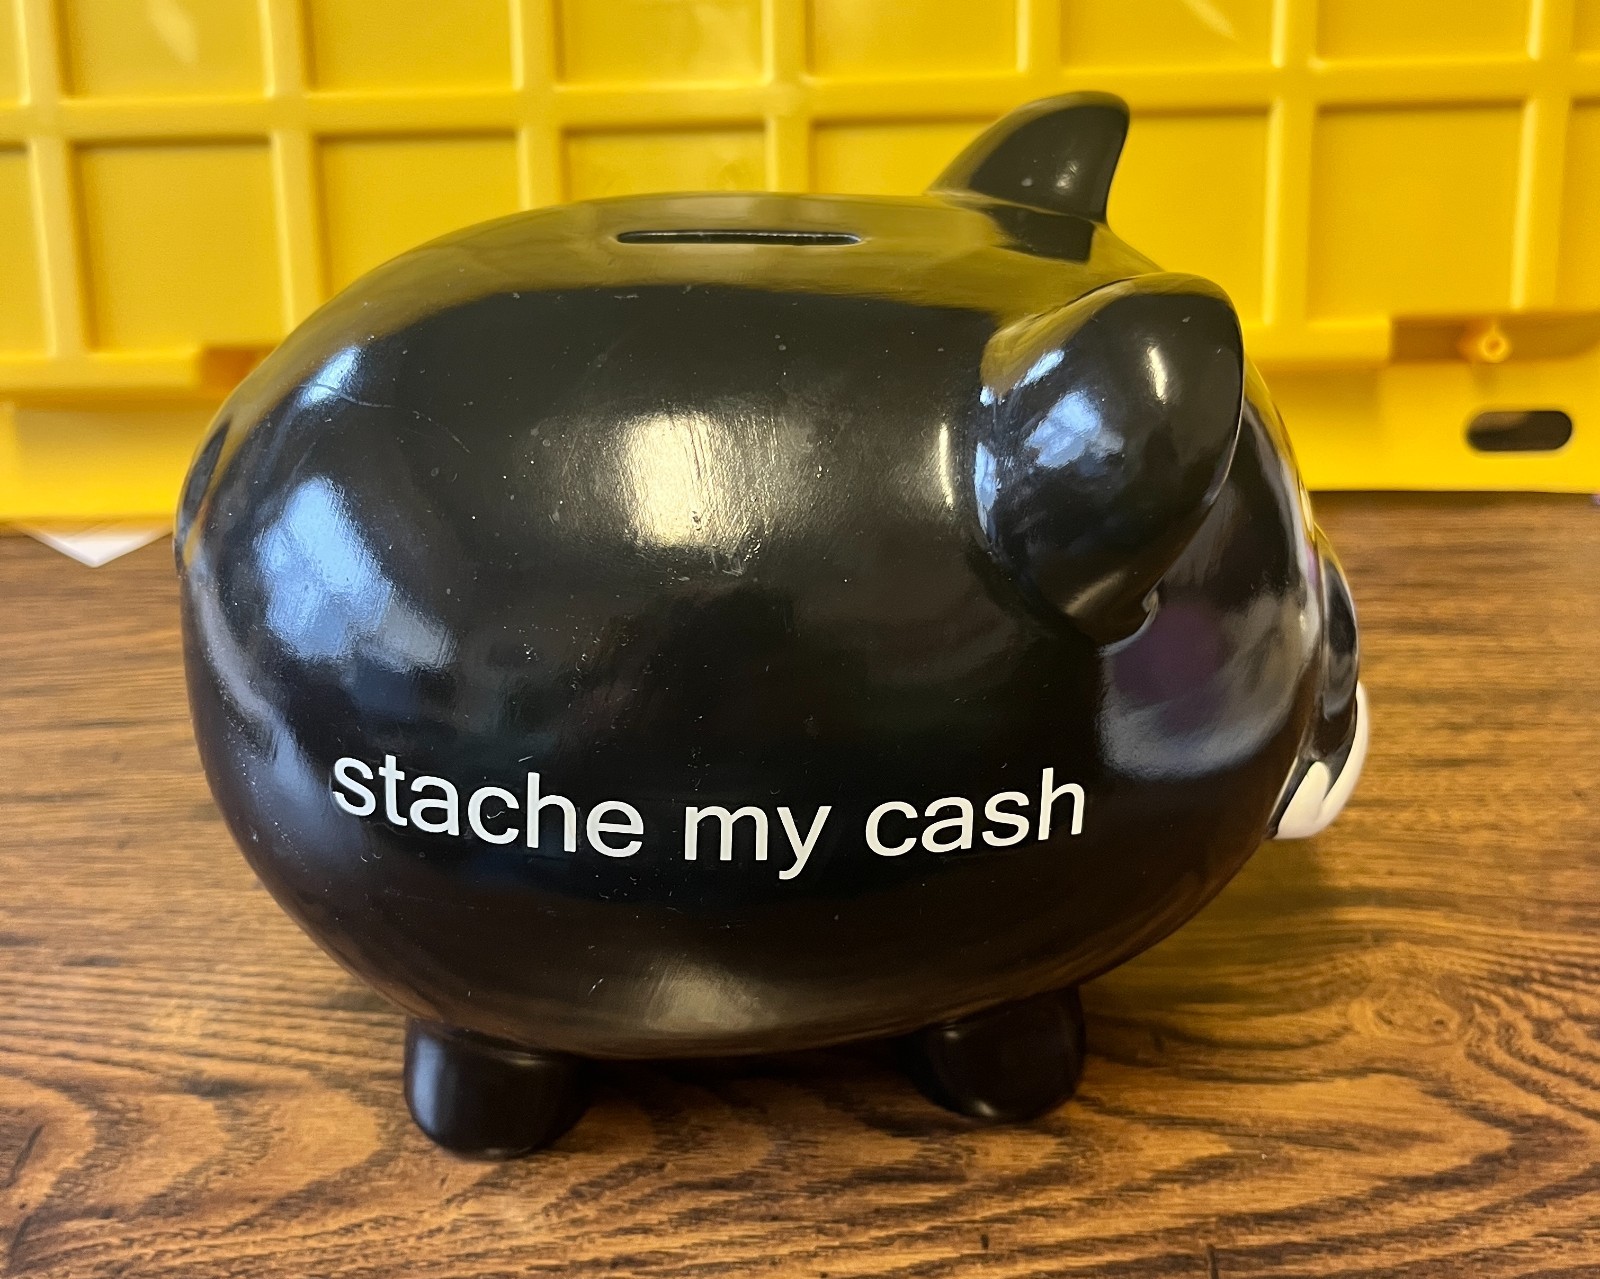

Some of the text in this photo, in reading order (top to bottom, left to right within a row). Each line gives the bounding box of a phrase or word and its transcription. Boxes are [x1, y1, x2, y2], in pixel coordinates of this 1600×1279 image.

[332, 754, 1085, 880] stache my cash
